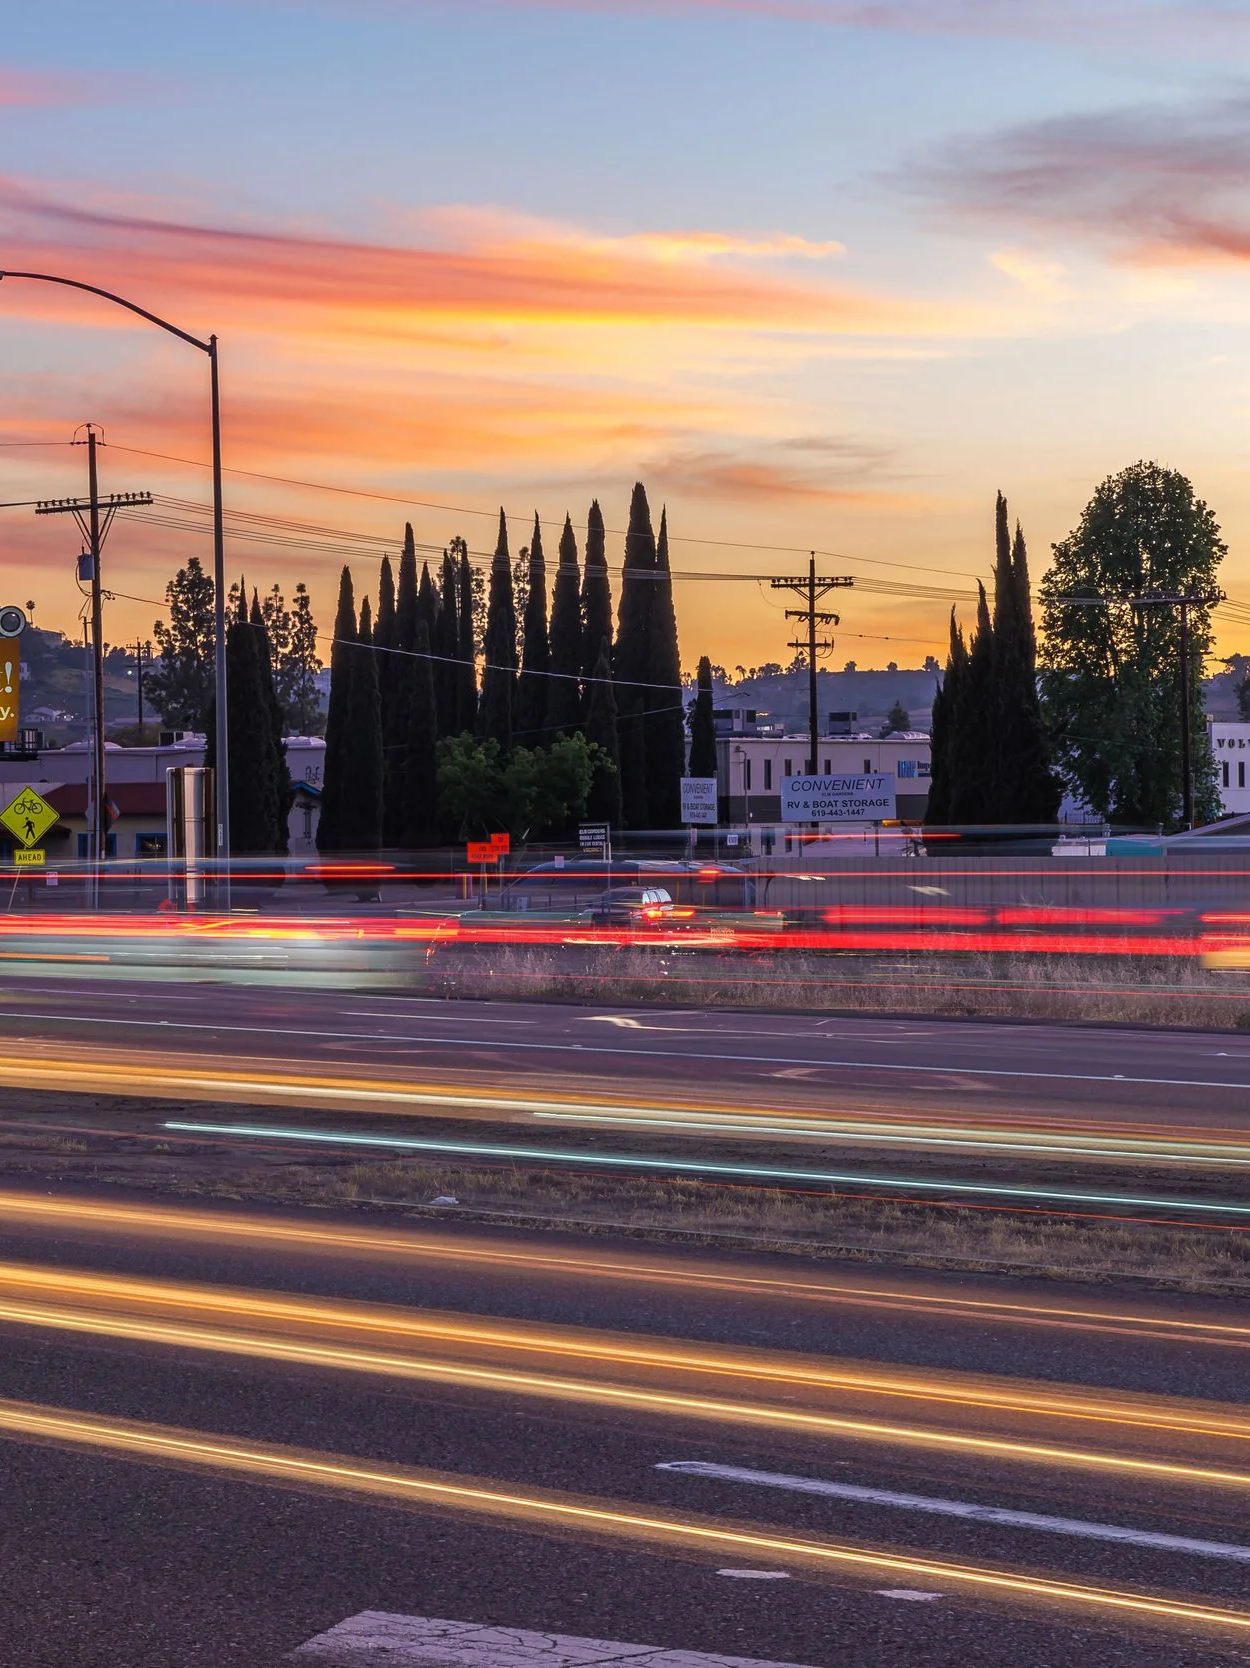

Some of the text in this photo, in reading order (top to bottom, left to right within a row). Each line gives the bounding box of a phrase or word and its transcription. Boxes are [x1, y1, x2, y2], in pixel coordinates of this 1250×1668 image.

[791, 778, 884, 792] CONVENIENT
[787, 799, 889, 809] RV & BOAT STORAGE
[811, 808, 865, 817] 619-443-1447
